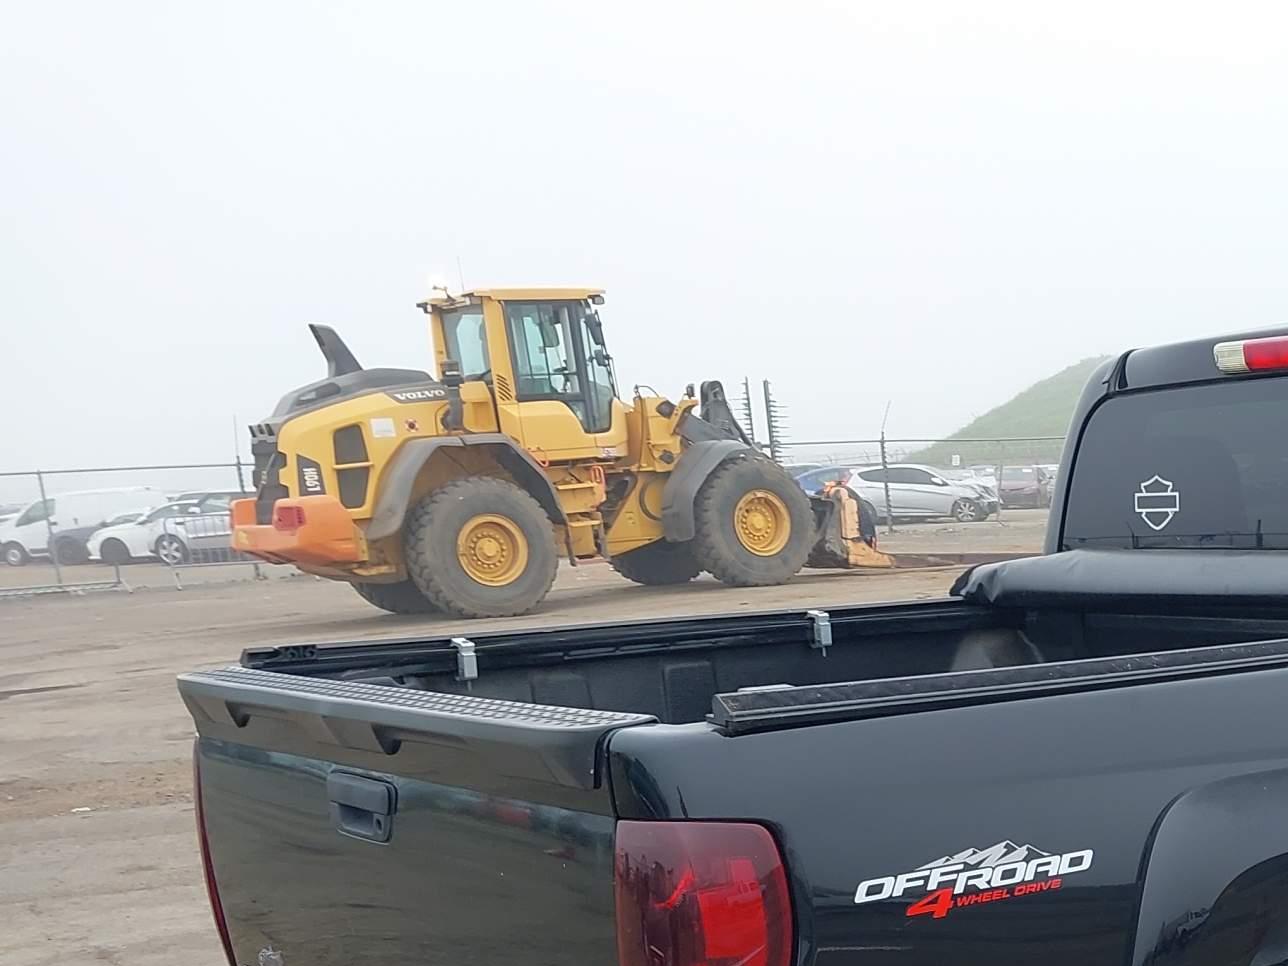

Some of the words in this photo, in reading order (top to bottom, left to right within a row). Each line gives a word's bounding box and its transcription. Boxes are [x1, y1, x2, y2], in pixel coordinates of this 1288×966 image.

[394, 389, 446, 401] VOLVO
[302, 467, 322, 492] L90H
[853, 848, 1095, 905] OFFROAD
[904, 888, 954, 919] 4
[956, 888, 1011, 908] WHEEL
[1014, 878, 1063, 898] DRIVE
